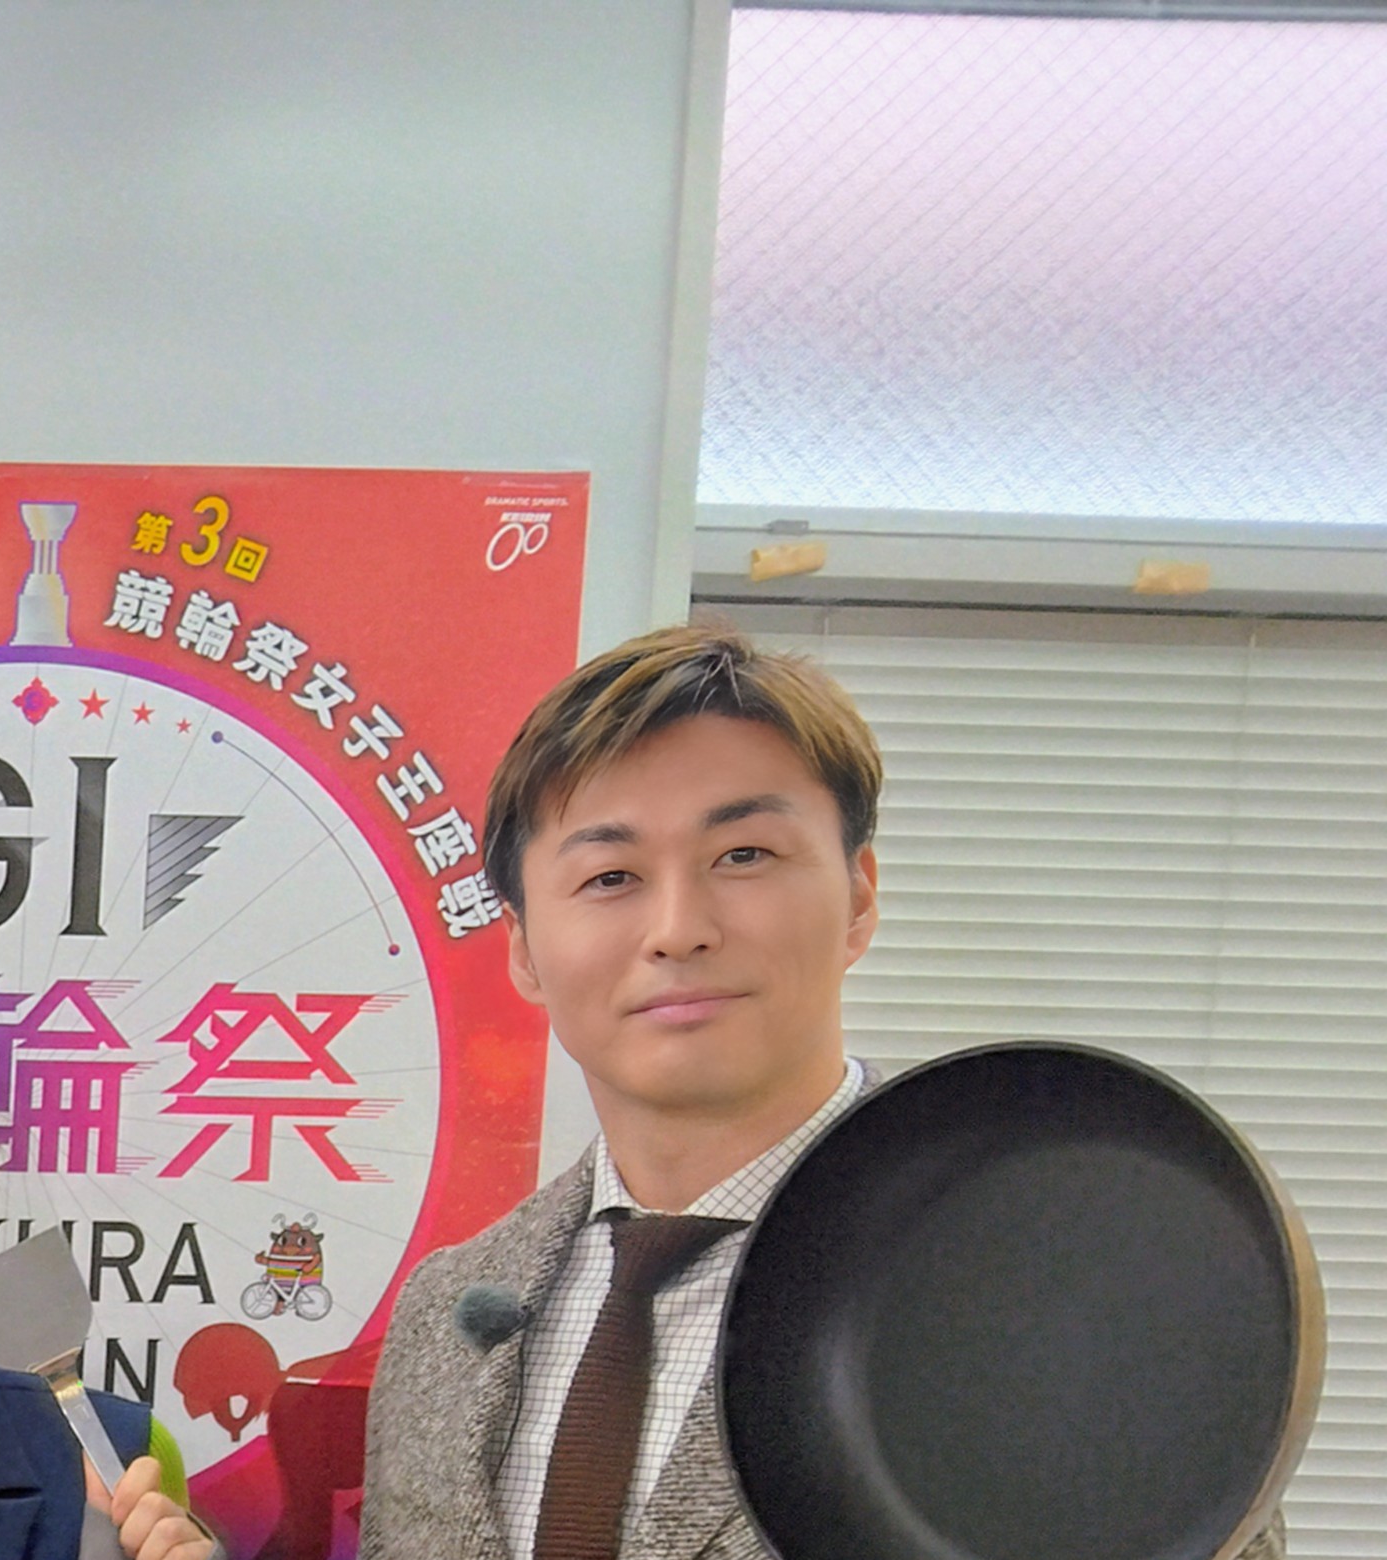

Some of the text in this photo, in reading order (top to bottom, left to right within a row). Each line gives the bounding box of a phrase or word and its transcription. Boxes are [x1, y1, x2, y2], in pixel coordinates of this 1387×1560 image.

[131, 495, 270, 583] 第3回
[103, 570, 505, 939] 競輪祭女子王座戦
